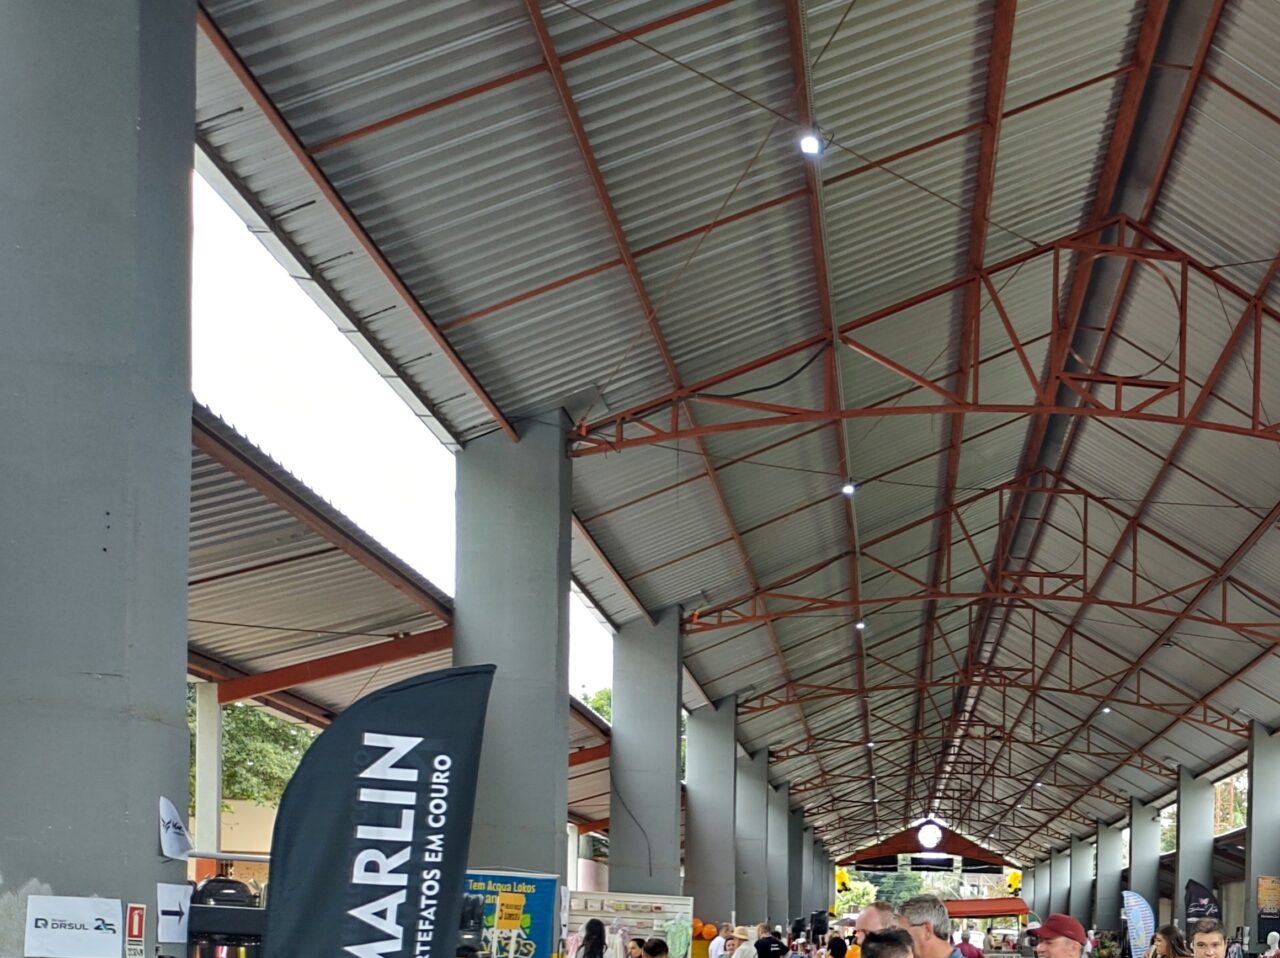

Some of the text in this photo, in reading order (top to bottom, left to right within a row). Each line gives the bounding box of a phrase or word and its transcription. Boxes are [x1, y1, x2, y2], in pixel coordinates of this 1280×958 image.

[427, 754, 451, 828] COURO
[424, 833, 444, 862] EM
[467, 880, 486, 890] Tem
[51, 922, 89, 931] DRSUL
